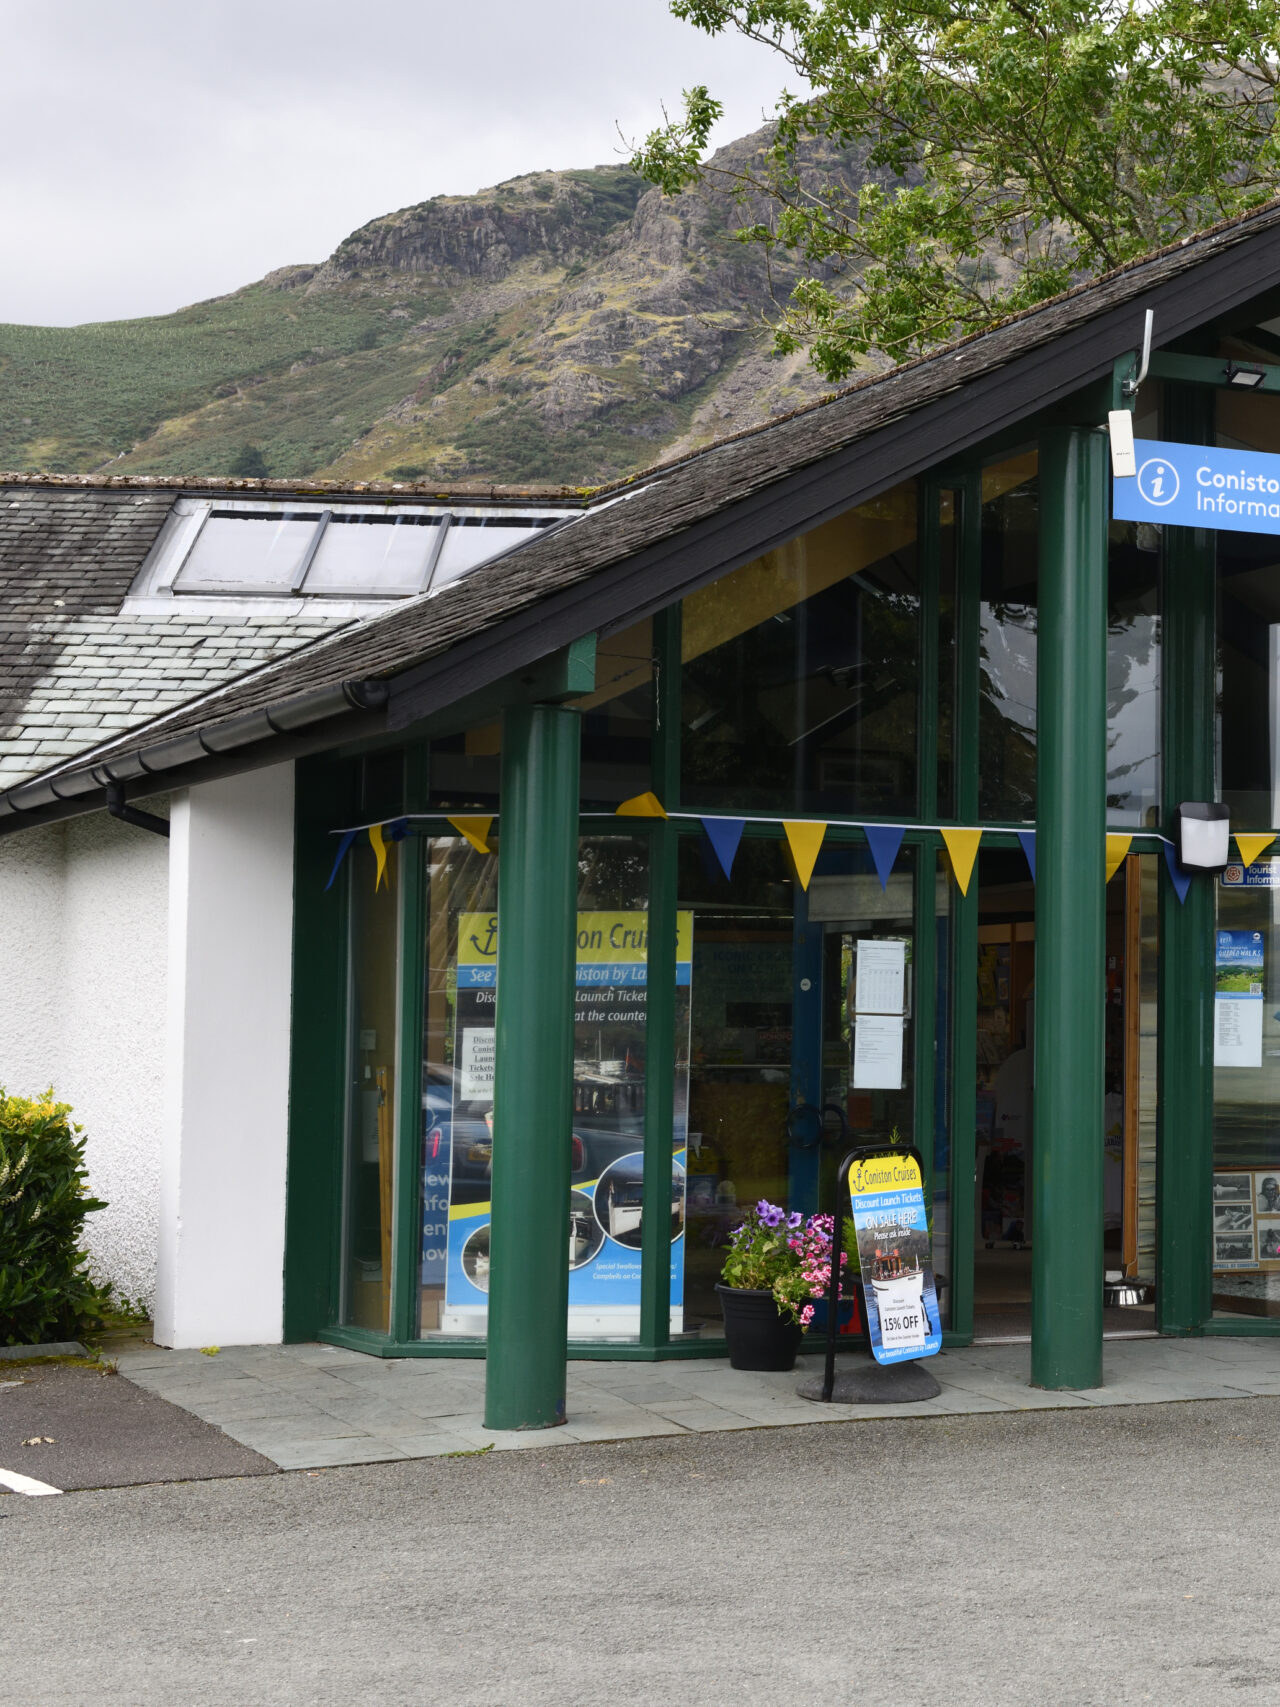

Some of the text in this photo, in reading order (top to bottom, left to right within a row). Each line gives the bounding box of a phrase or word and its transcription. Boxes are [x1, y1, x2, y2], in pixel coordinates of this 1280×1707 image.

[1248, 865, 1277, 875] Tourist
[470, 968, 493, 982] See
[613, 967, 629, 984] by
[575, 989, 615, 1002] Launch
[617, 990, 647, 1002] Ticket
[588, 1009, 606, 1021] the
[864, 1166, 917, 1185] Coniston Cruises
[855, 1193, 922, 1210] Discount Launch Tickets
[866, 1211, 918, 1230] ON SALE HERE
[874, 1228, 913, 1241] Please ask inside
[884, 1315, 919, 1331] 15% OFF
[924, 1342, 939, 1350] Launch
